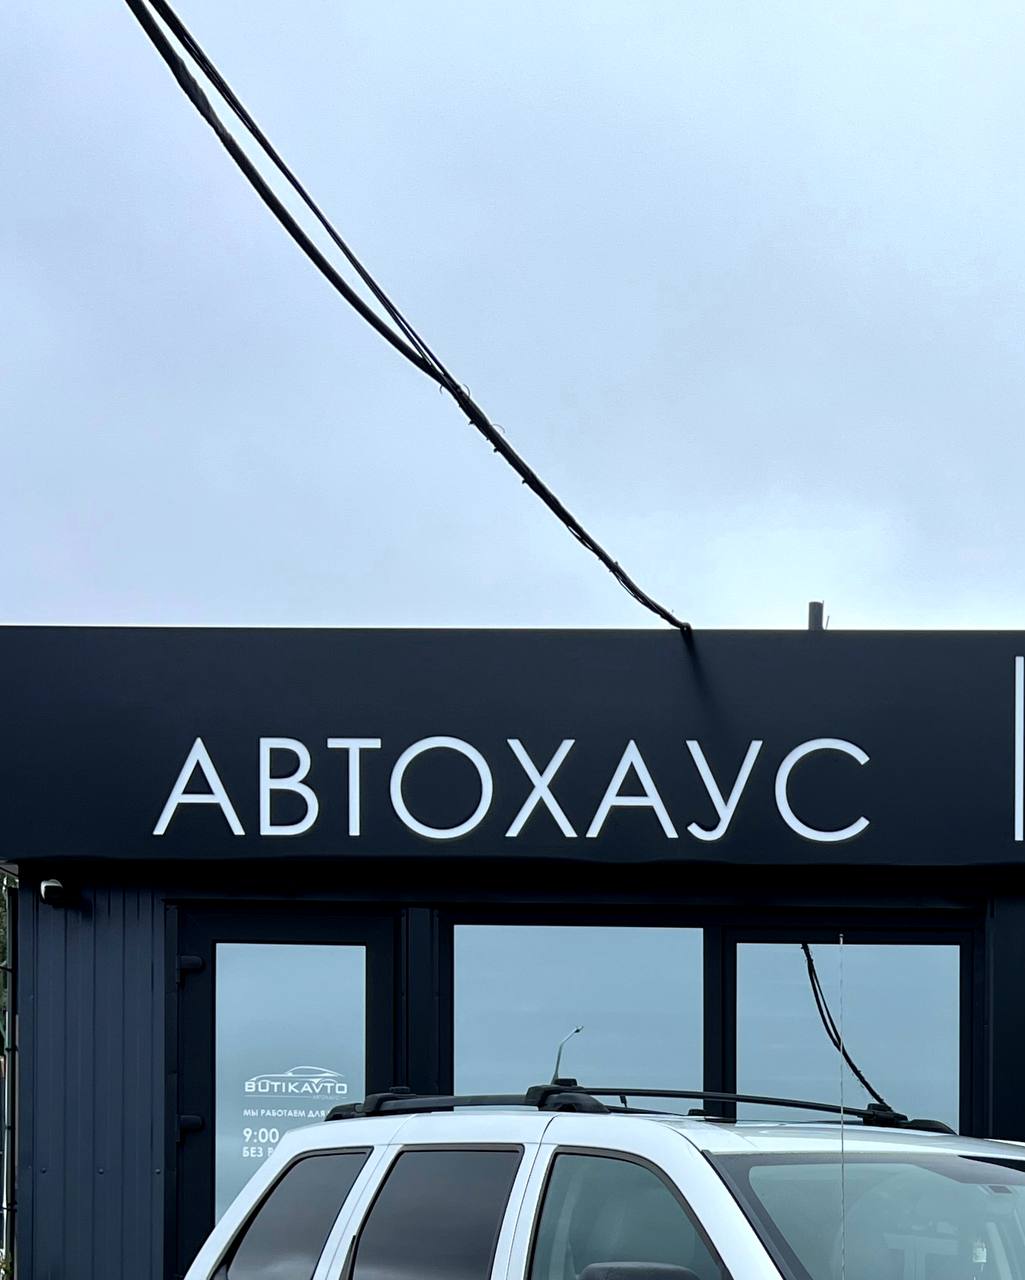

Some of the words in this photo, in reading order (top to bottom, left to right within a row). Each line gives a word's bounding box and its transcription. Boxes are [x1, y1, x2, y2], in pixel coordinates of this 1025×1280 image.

[152, 736, 870, 842] АВТОХАУС
[244, 1081, 348, 1094] BUTIKAVTO
[243, 1109, 259, 1117] МЫ
[260, 1109, 306, 1118] РАБОТАЕМ
[242, 1127, 280, 1143] 9:00
[242, 1146, 264, 1157] БЕЗ
